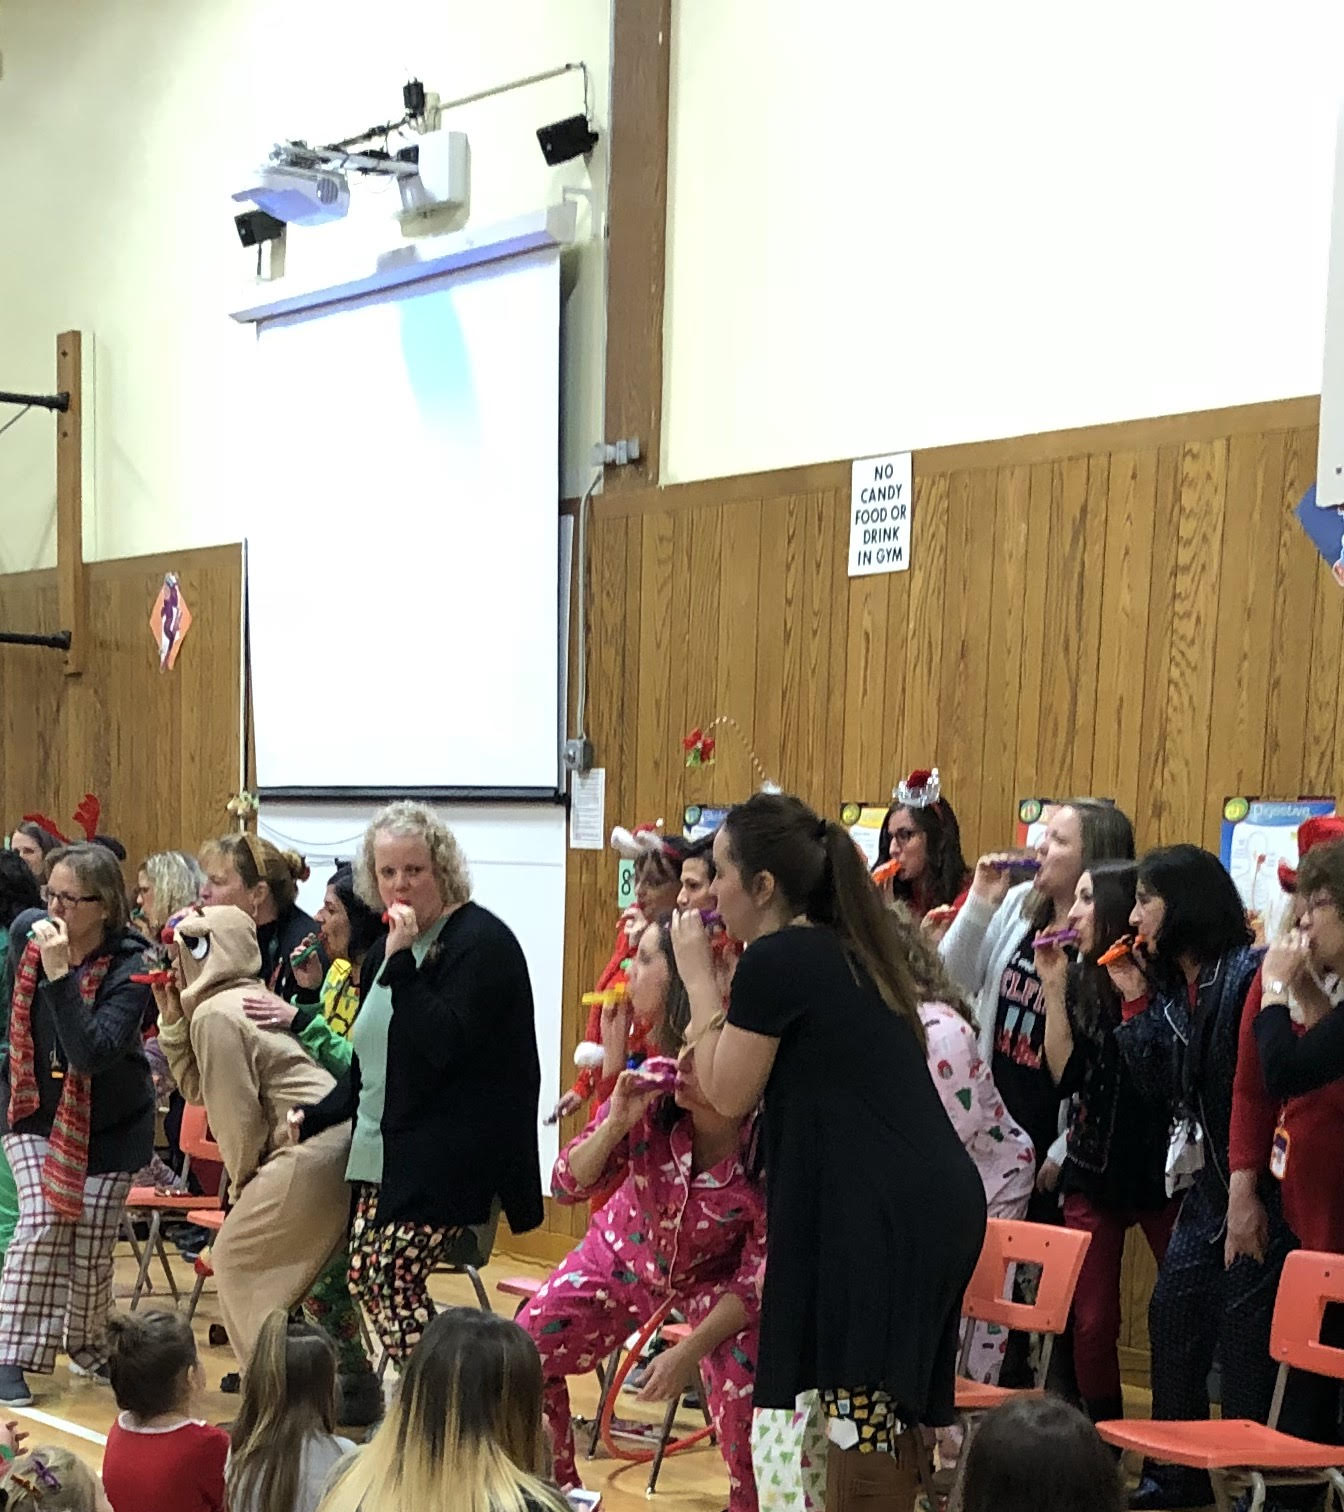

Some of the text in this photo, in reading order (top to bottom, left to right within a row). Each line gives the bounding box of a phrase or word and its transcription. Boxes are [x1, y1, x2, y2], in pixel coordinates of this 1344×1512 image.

[874, 463, 894, 481] NO
[861, 484, 902, 504] CANDY
[855, 504, 906, 525] FOOD OR
[863, 526, 900, 545] DRINK
[858, 547, 902, 566] IN GYM
[621, 869, 632, 895] 8
